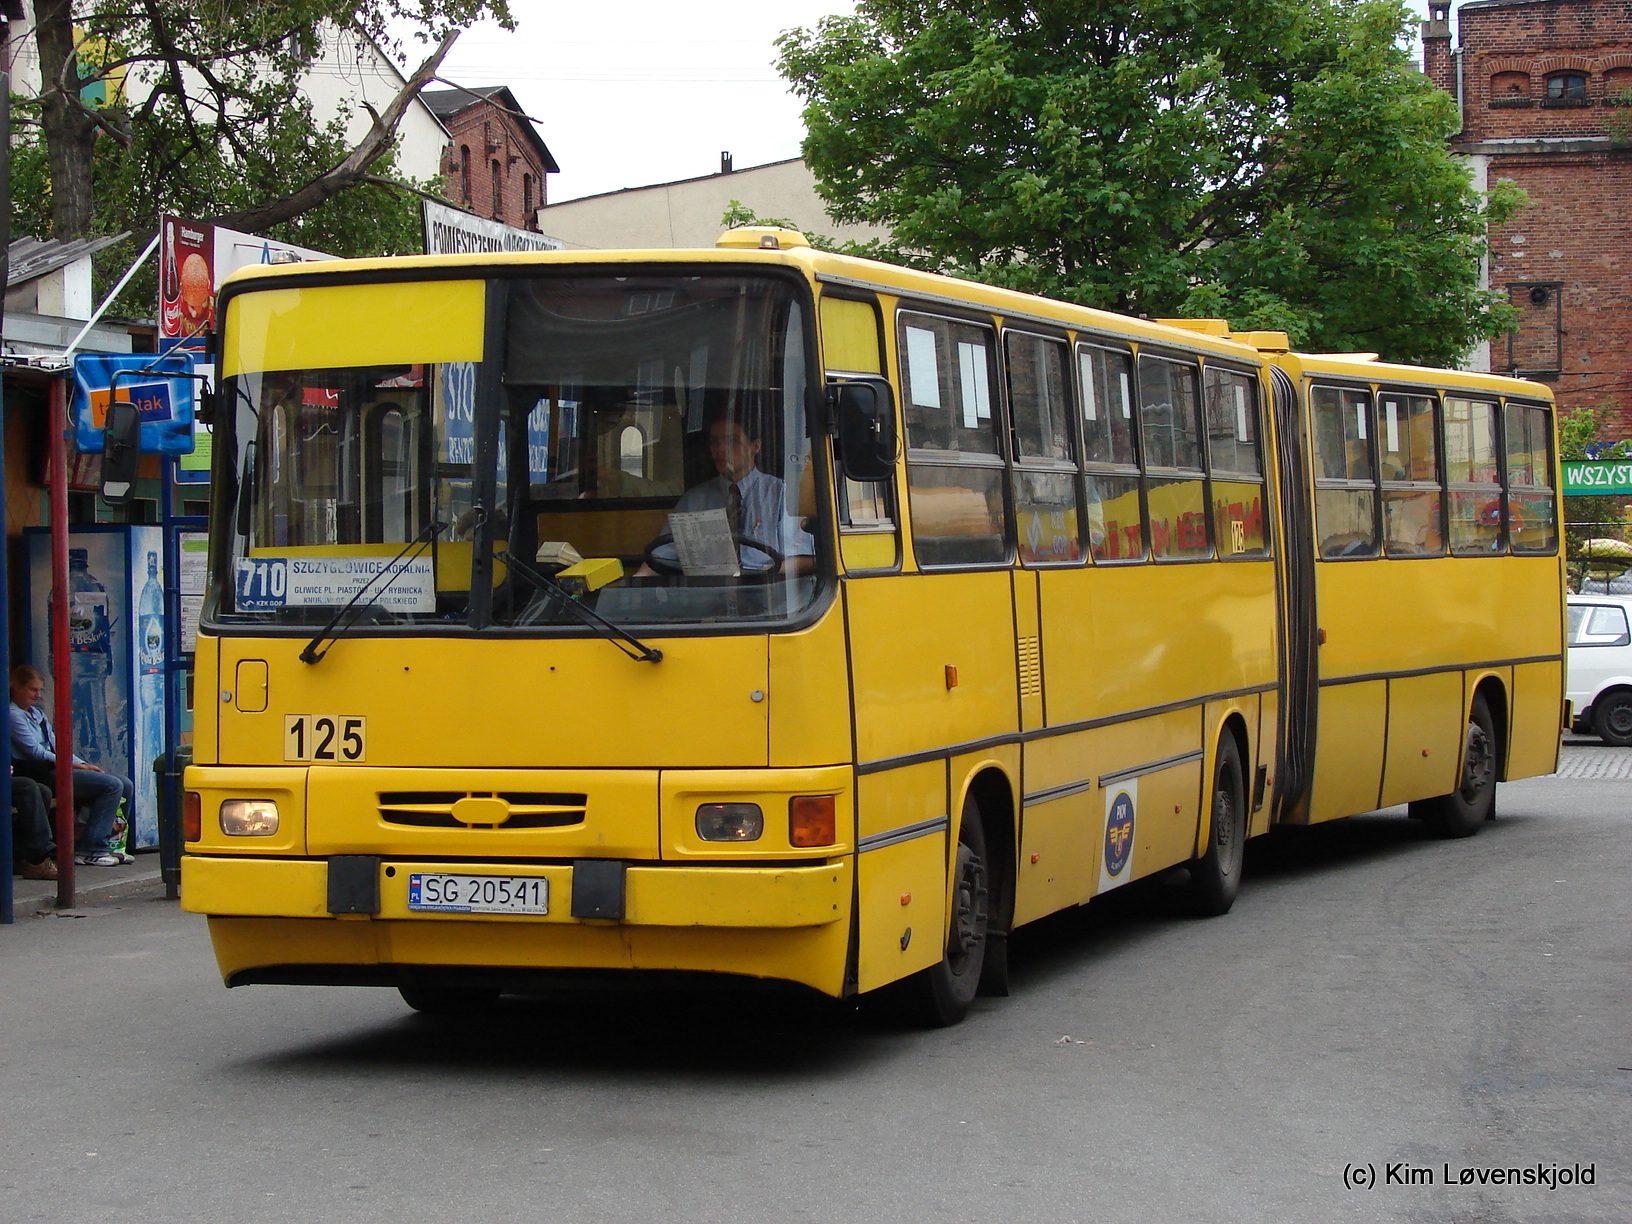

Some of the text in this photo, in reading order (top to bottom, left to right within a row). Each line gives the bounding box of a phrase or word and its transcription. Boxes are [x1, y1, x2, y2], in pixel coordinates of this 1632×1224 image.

[181, 226, 204, 243] Hamburger
[138, 395, 163, 411] tak
[1232, 522, 1244, 551] 125
[238, 561, 286, 597] 710
[294, 586, 322, 594] GLIWICE
[290, 717, 363, 760] 125
[411, 878, 539, 906] PL SG 20541
